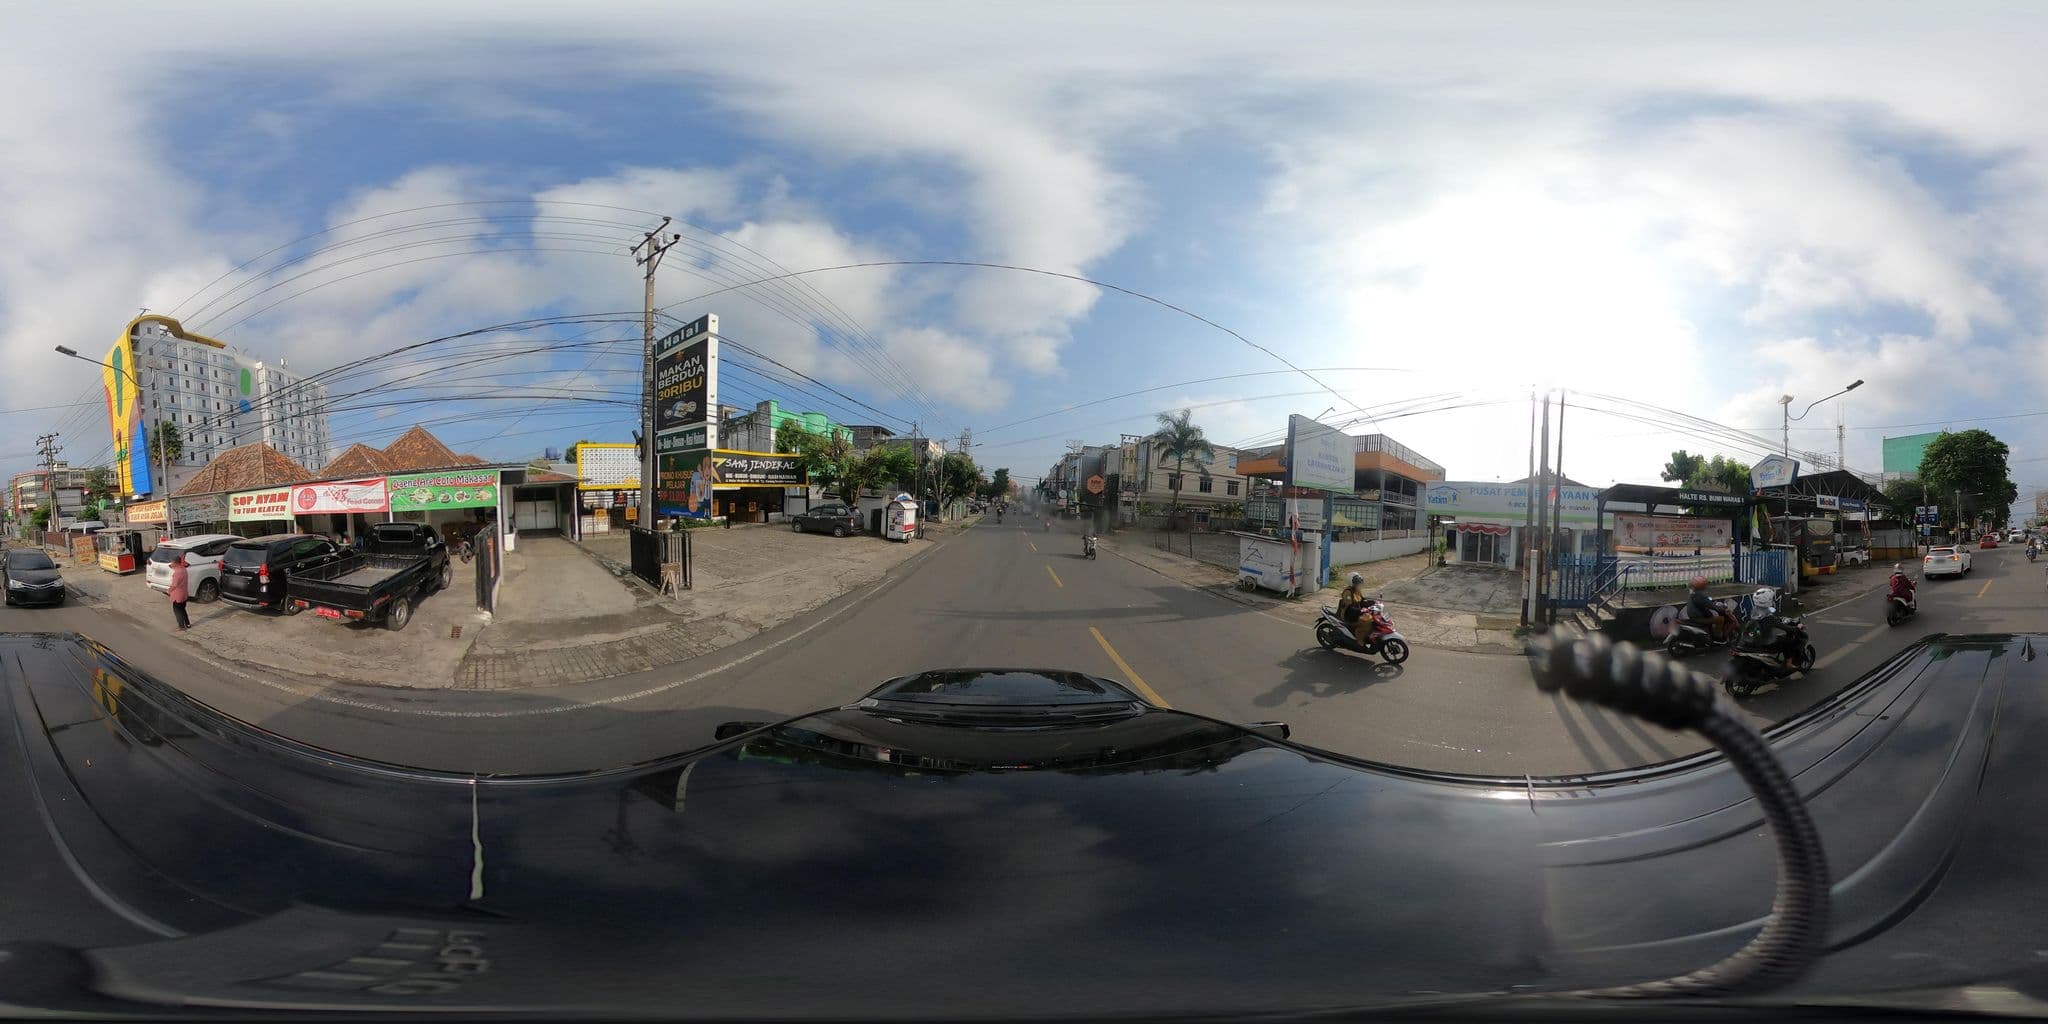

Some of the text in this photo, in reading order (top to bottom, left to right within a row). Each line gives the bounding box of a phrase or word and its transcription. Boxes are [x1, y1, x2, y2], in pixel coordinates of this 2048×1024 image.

[663, 322, 699, 349] Halal
[659, 355, 700, 380] MAKAN
[658, 364, 705, 390] BERDUA
[658, 375, 703, 401] 30RIBU
[725, 458, 796, 472] SANG JENDERAL
[1470, 487, 1501, 496] PUSAT
[1679, 492, 1698, 501] HALTE
[233, 496, 254, 506] SOP
[256, 492, 289, 504] AYAM
[1428, 494, 1448, 504] Yatim
[1819, 497, 1836, 506] Mobil
